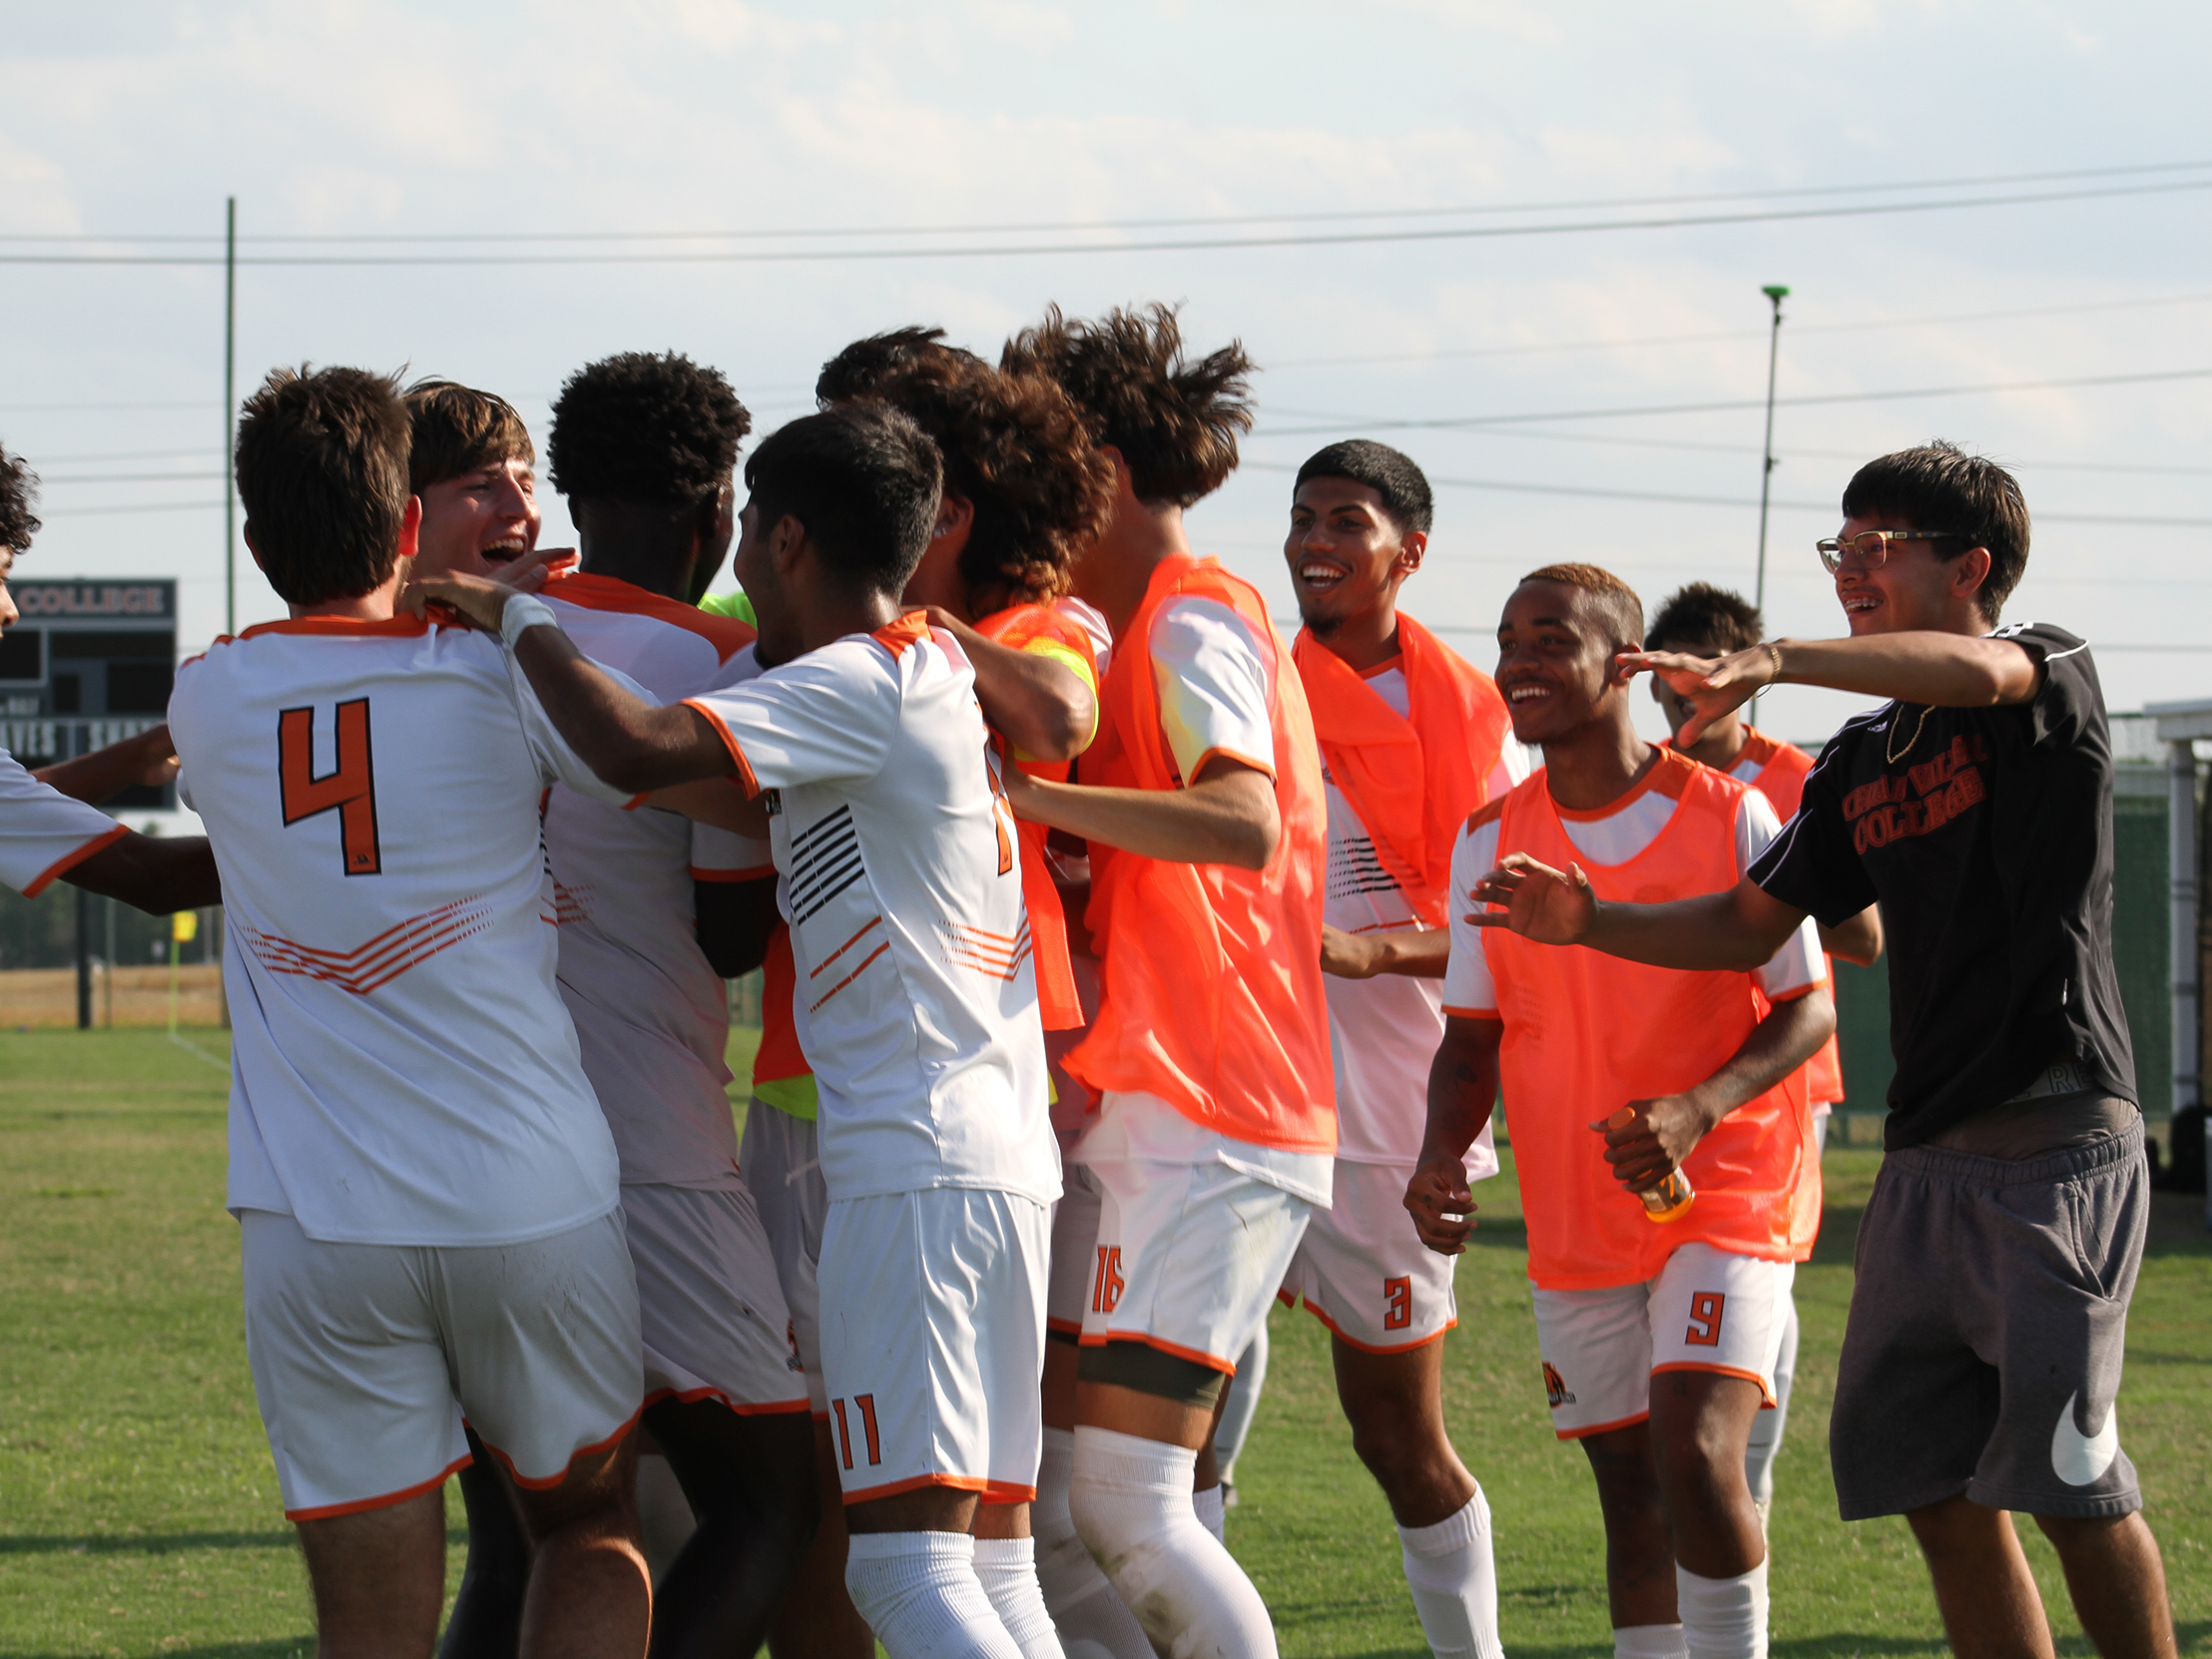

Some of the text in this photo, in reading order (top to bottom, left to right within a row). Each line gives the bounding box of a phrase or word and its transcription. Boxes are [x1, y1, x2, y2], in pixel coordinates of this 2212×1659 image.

[18, 587, 164, 613] COLLEGE
[278, 696, 381, 876] 4
[1854, 766, 1986, 854] COLLEGE
[1092, 1245, 1124, 1313] 16
[1384, 1276, 1410, 1331] 3
[1685, 1292, 1725, 1347] 9
[831, 1393, 880, 1470] 11
